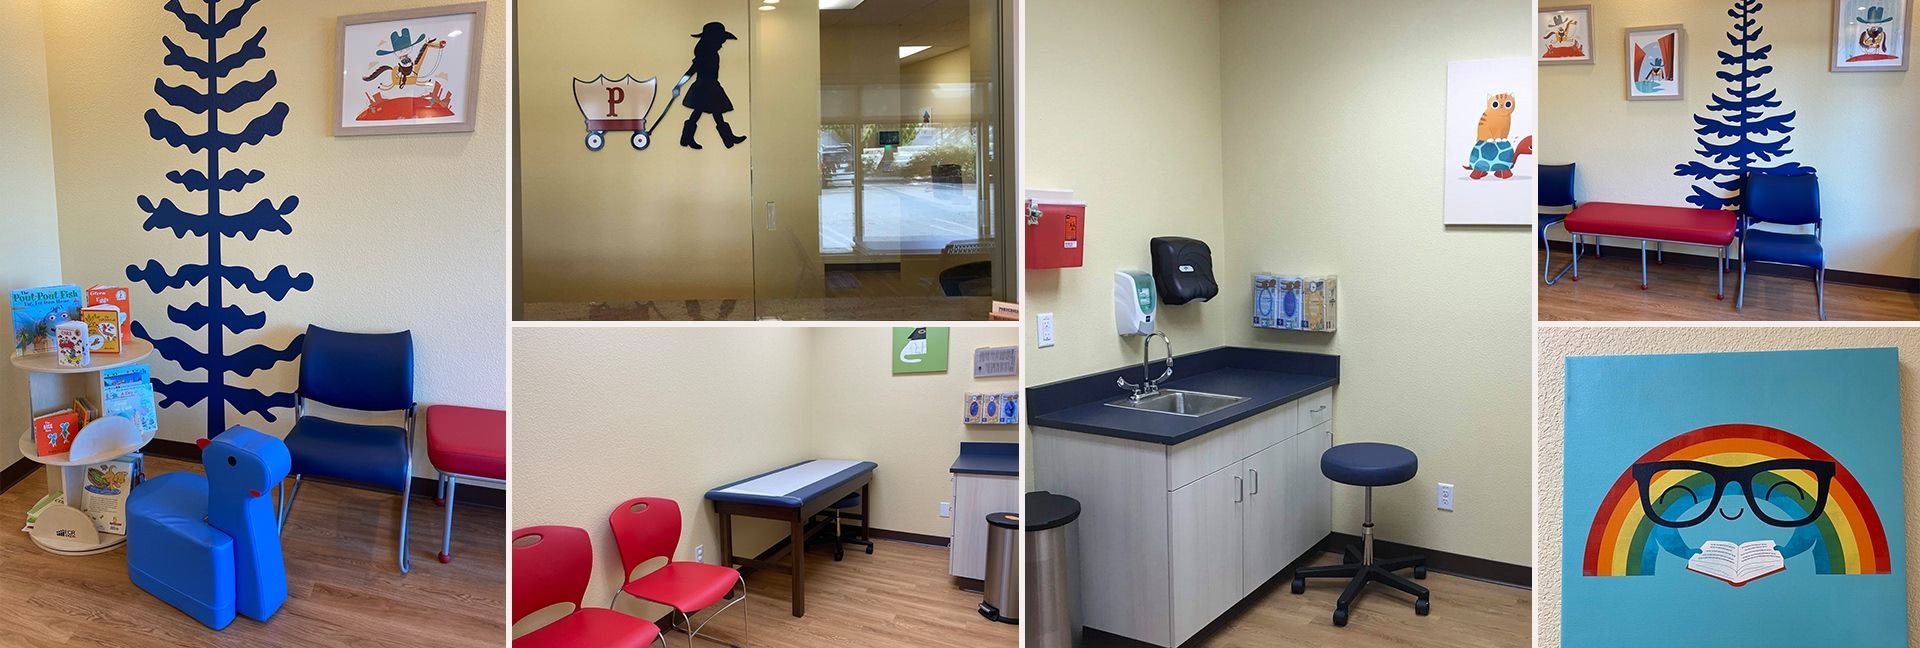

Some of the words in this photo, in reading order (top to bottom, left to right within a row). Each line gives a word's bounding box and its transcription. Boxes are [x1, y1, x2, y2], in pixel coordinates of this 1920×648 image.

[605, 86, 625, 117] P
[13, 291, 58, 302] Pout-Pout
[60, 290, 78, 299] Fish
